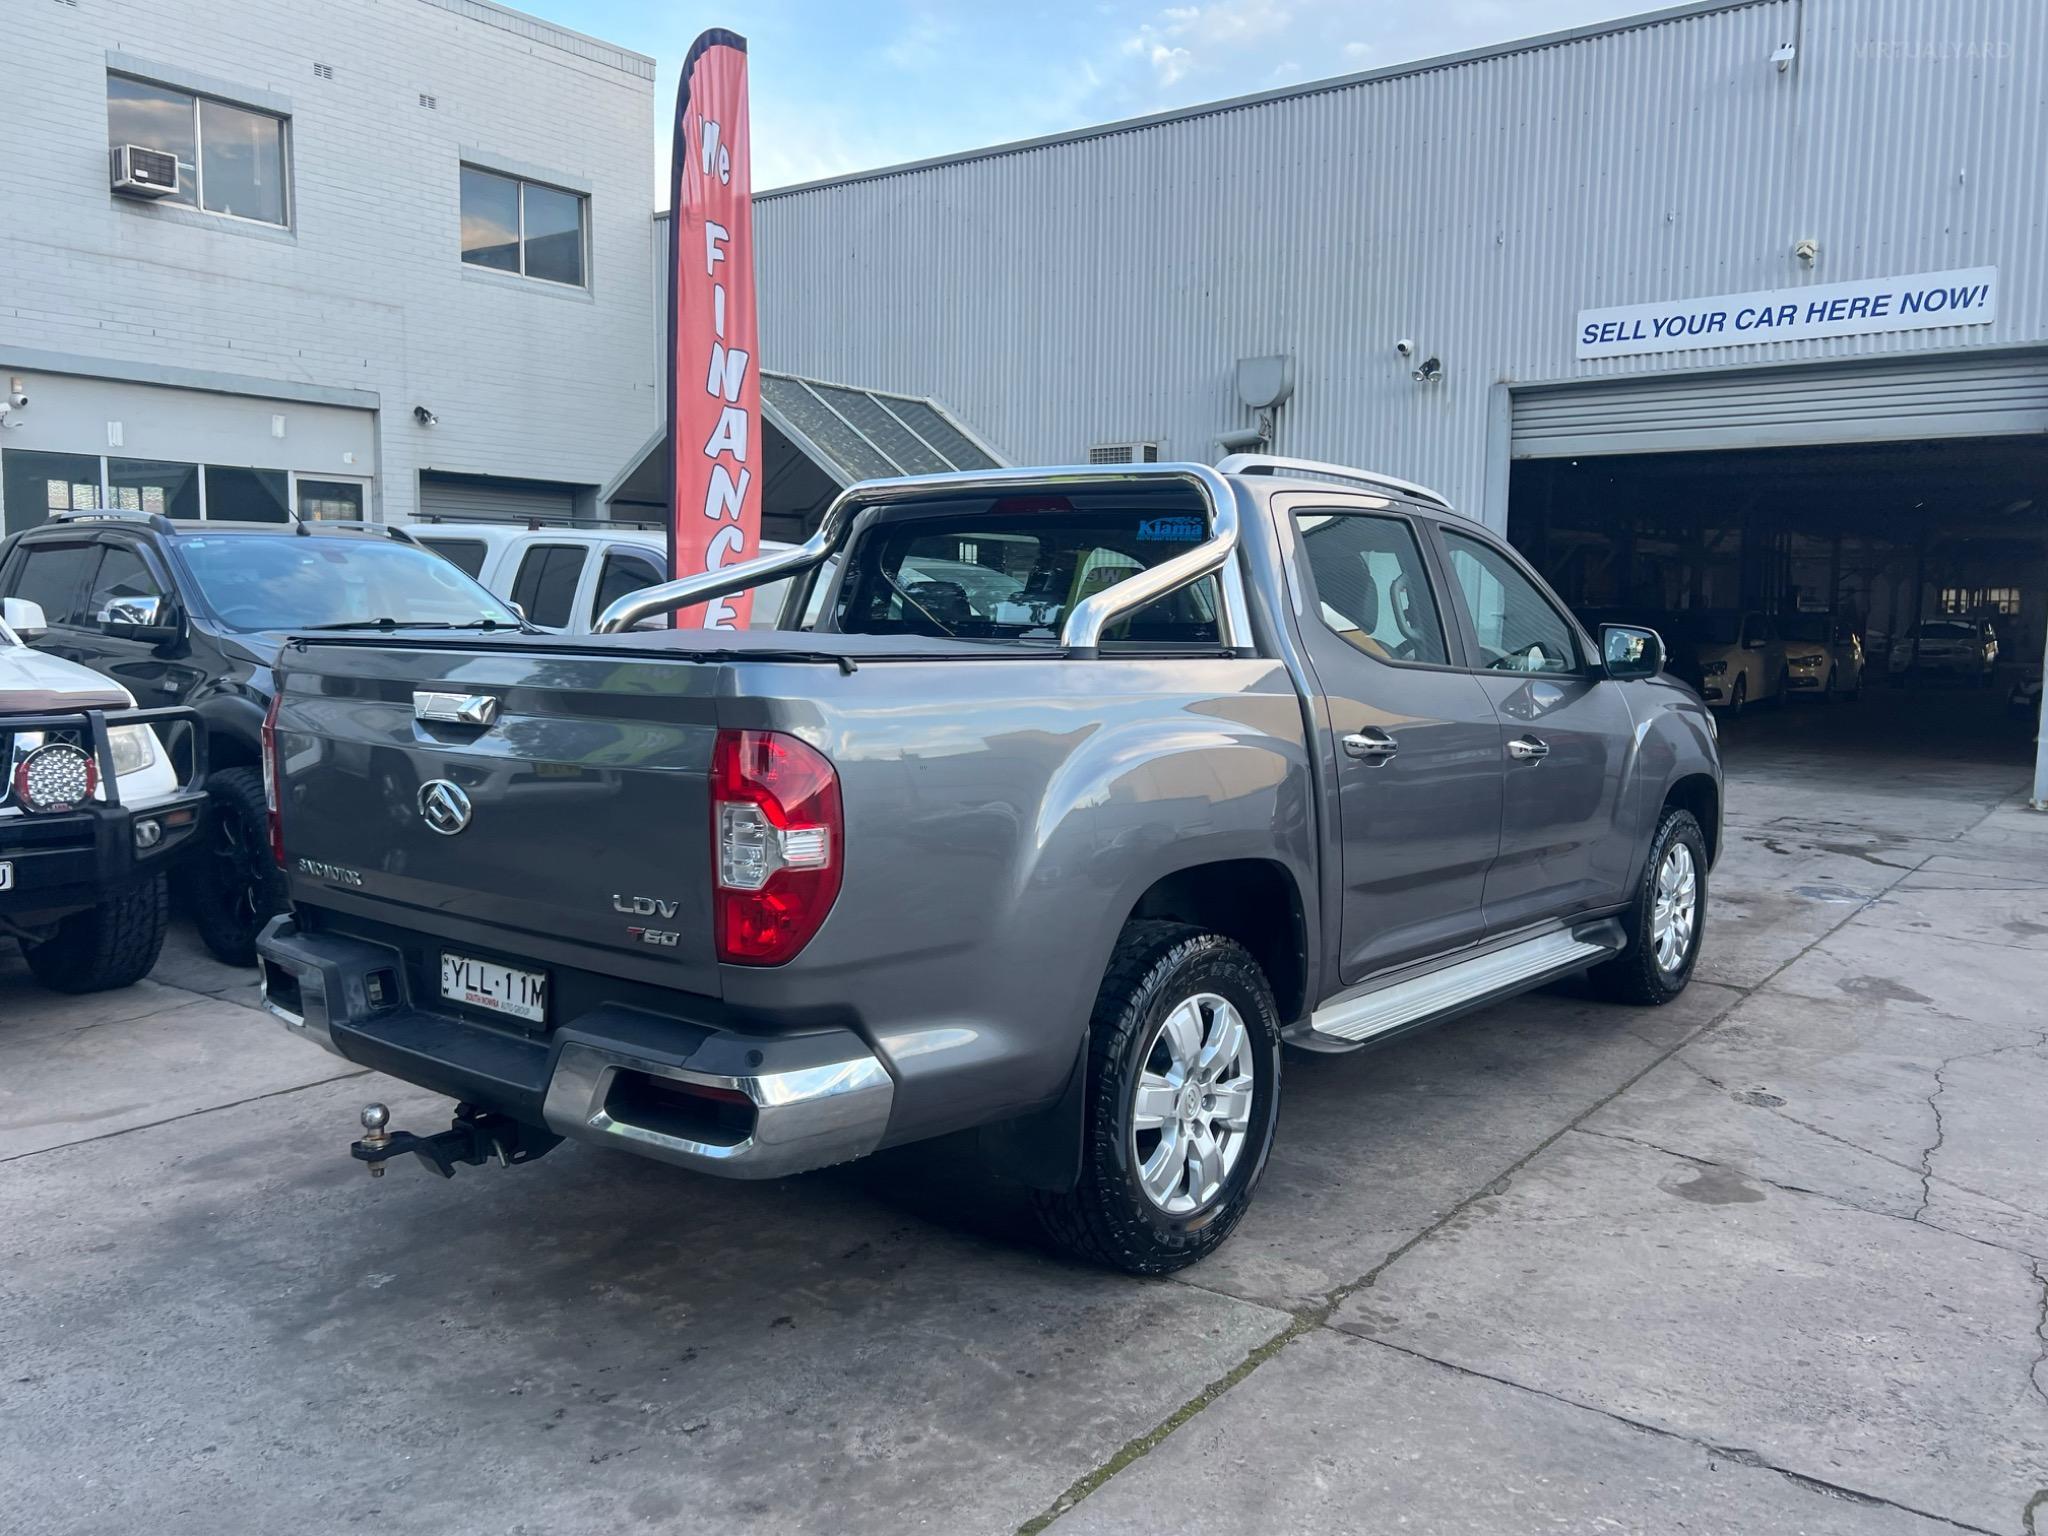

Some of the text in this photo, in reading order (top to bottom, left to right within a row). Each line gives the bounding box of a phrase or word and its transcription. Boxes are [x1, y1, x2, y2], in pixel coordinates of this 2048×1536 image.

[1581, 284, 1989, 345] SELL YOUR CAR HERE NOW!
[612, 894, 680, 919] LDV
